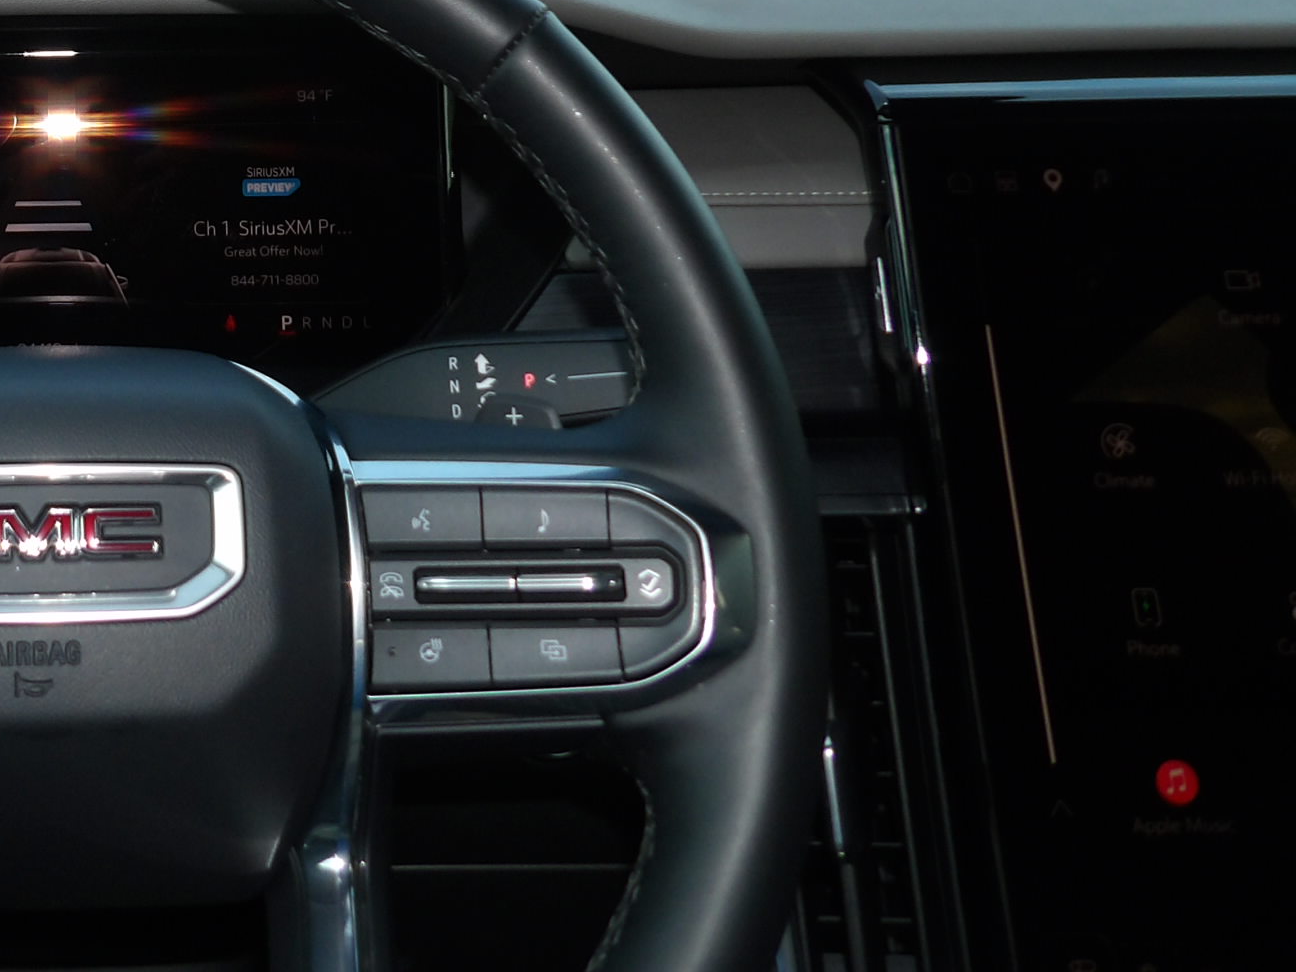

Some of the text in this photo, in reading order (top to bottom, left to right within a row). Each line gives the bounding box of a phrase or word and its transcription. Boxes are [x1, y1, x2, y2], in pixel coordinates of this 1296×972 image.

[246, 166, 296, 178] SIRIUSXM
[246, 182, 296, 193] PREVIEW
[193, 218, 353, 237] Ch 1 SiriusXM Pr...
[224, 244, 324, 258] Great Offer Now!
[230, 273, 320, 287] 844-711-8800
[280, 315, 294, 331] P
[302, 316, 312, 330] R
[321, 316, 333, 330] N
[342, 316, 353, 330] D
[448, 356, 459, 371] R
[449, 379, 461, 394] N
[523, 372, 536, 389] P
[451, 403, 463, 419] D
[1093, 470, 1156, 490] Climate
[1126, 639, 1181, 658] Phone
